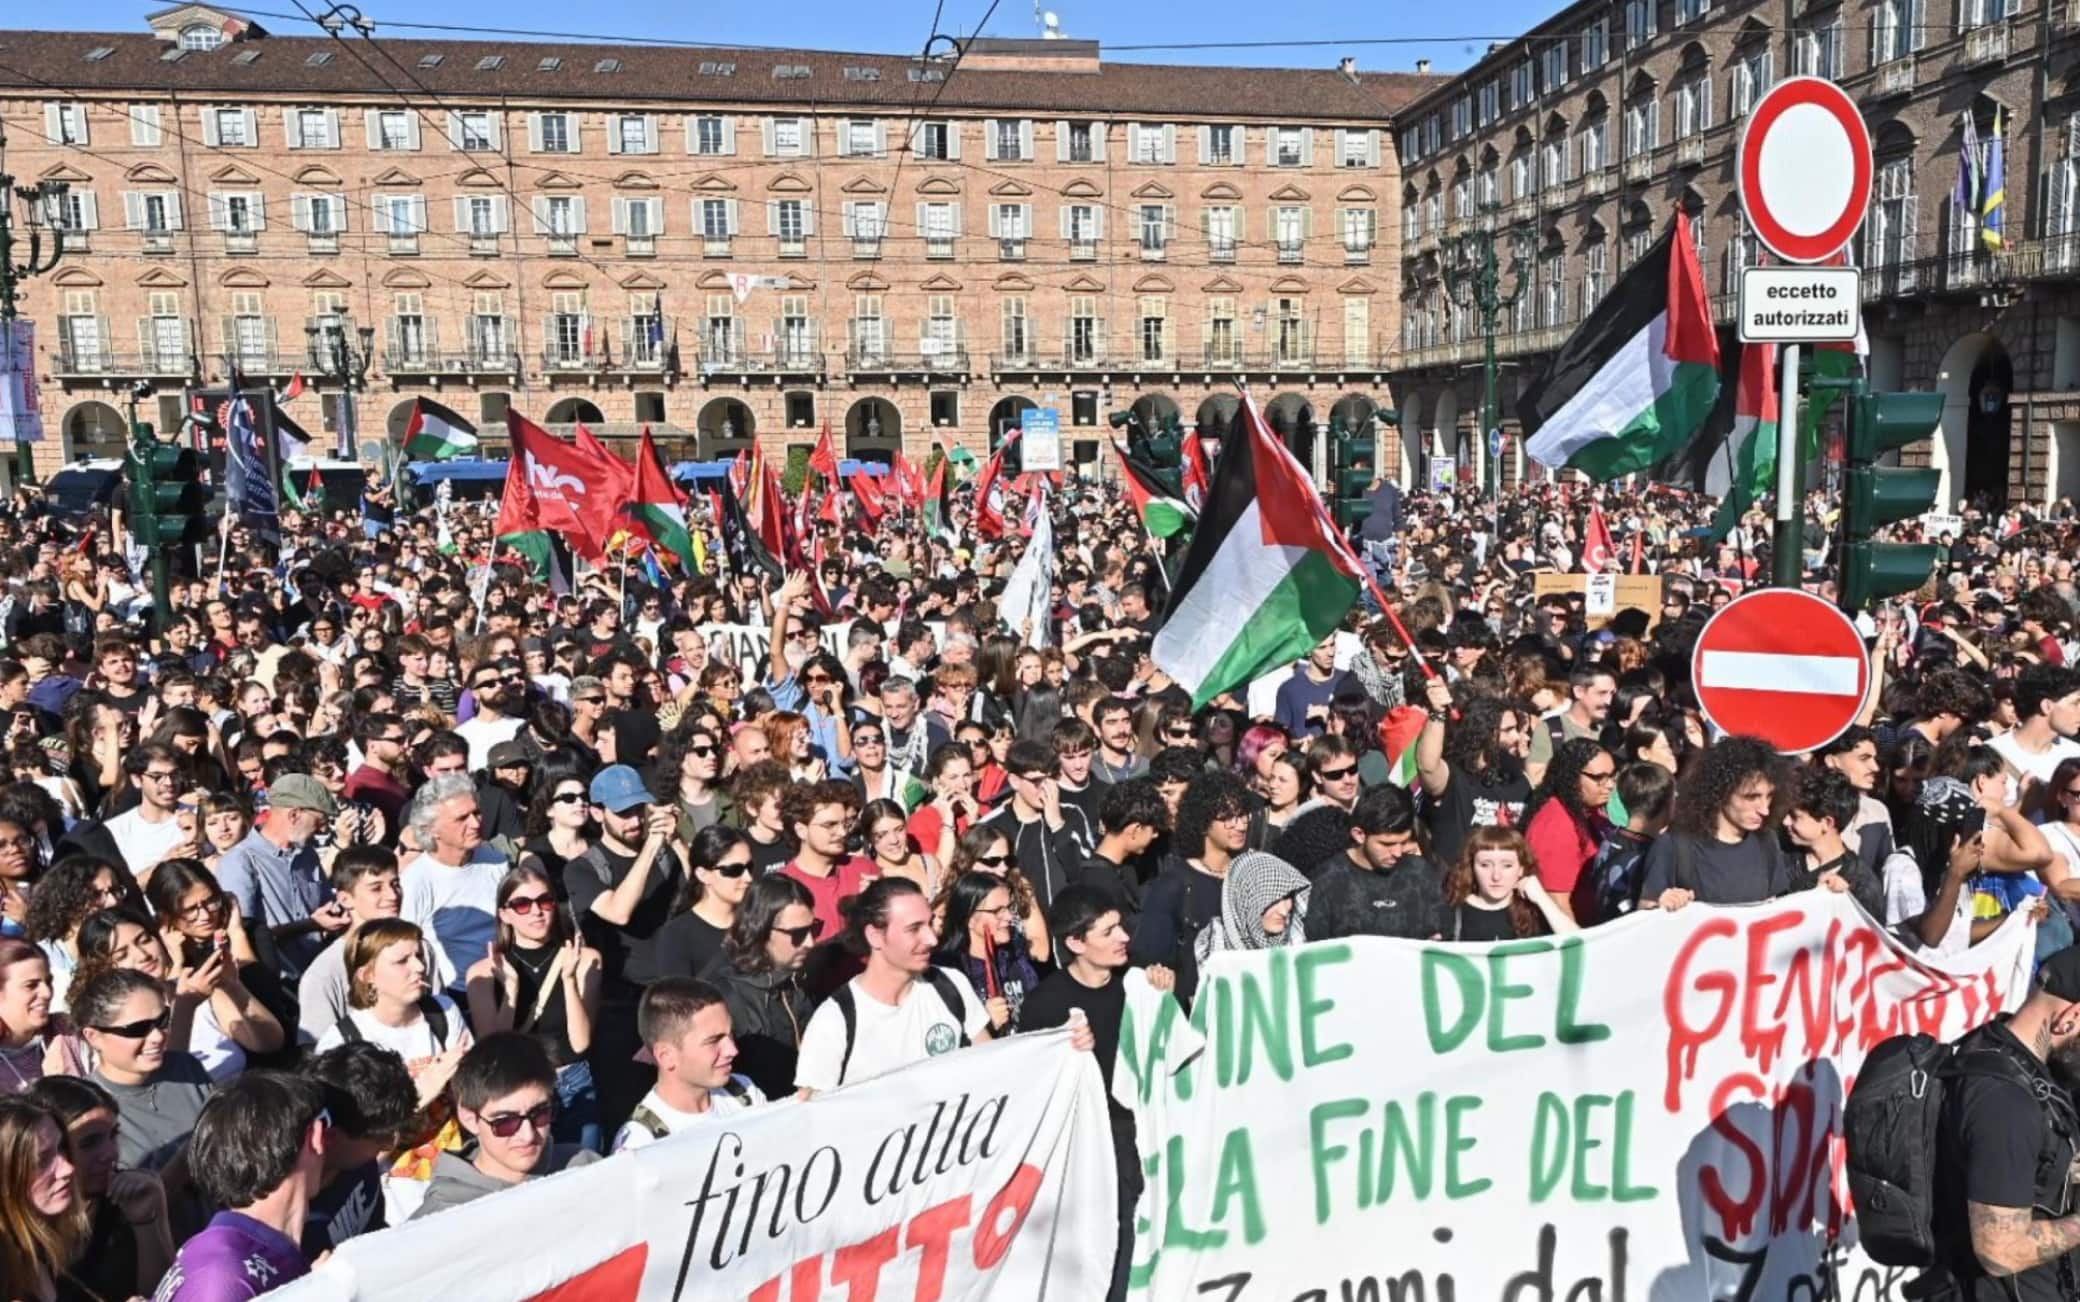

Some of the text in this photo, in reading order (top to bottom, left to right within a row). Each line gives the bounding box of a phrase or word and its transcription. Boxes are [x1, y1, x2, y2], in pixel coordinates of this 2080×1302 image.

[1753, 309, 1849, 326] autorizzati
[1766, 283, 1838, 299] eccetto
[1421, 937, 1611, 1054] DEL
[673, 1094, 1009, 1302] fino alla
[1310, 1090, 1493, 1225] FINE
[1528, 1089, 1659, 1203] DEL
